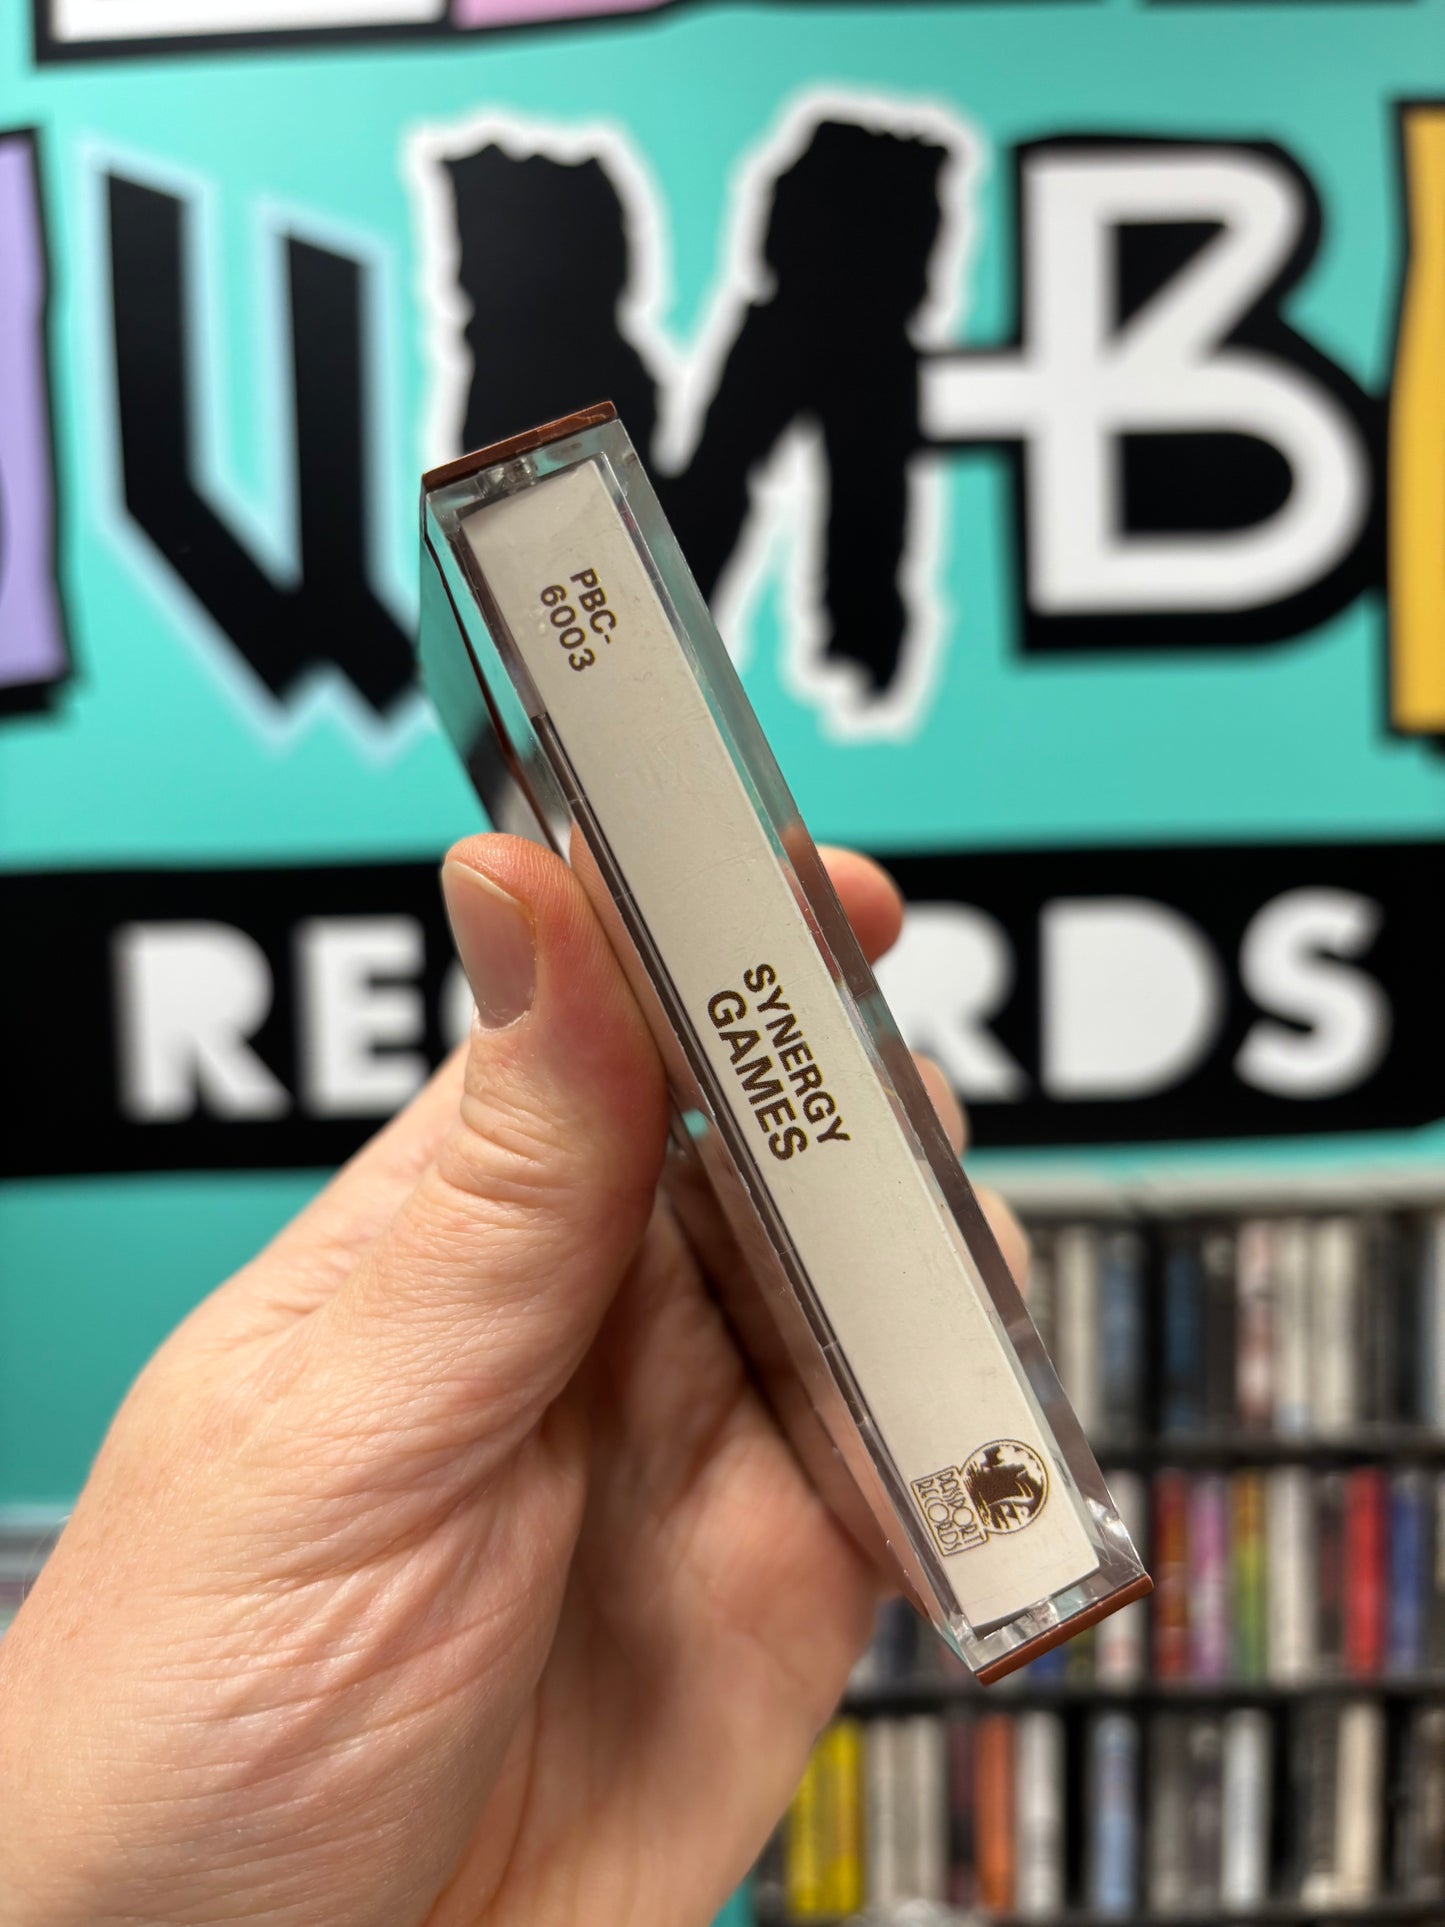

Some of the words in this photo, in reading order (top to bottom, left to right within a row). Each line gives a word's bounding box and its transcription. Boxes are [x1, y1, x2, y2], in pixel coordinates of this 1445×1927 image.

[540, 584, 596, 671] 6003
[570, 567, 617, 645] PBC-
[115, 888, 1393, 1123] RERDS
[707, 990, 808, 1160] GAMES
[743, 963, 852, 1143] SYNERGY
[915, 1478, 963, 1551] RECORDS
[935, 1470, 984, 1544] PASSPORT
